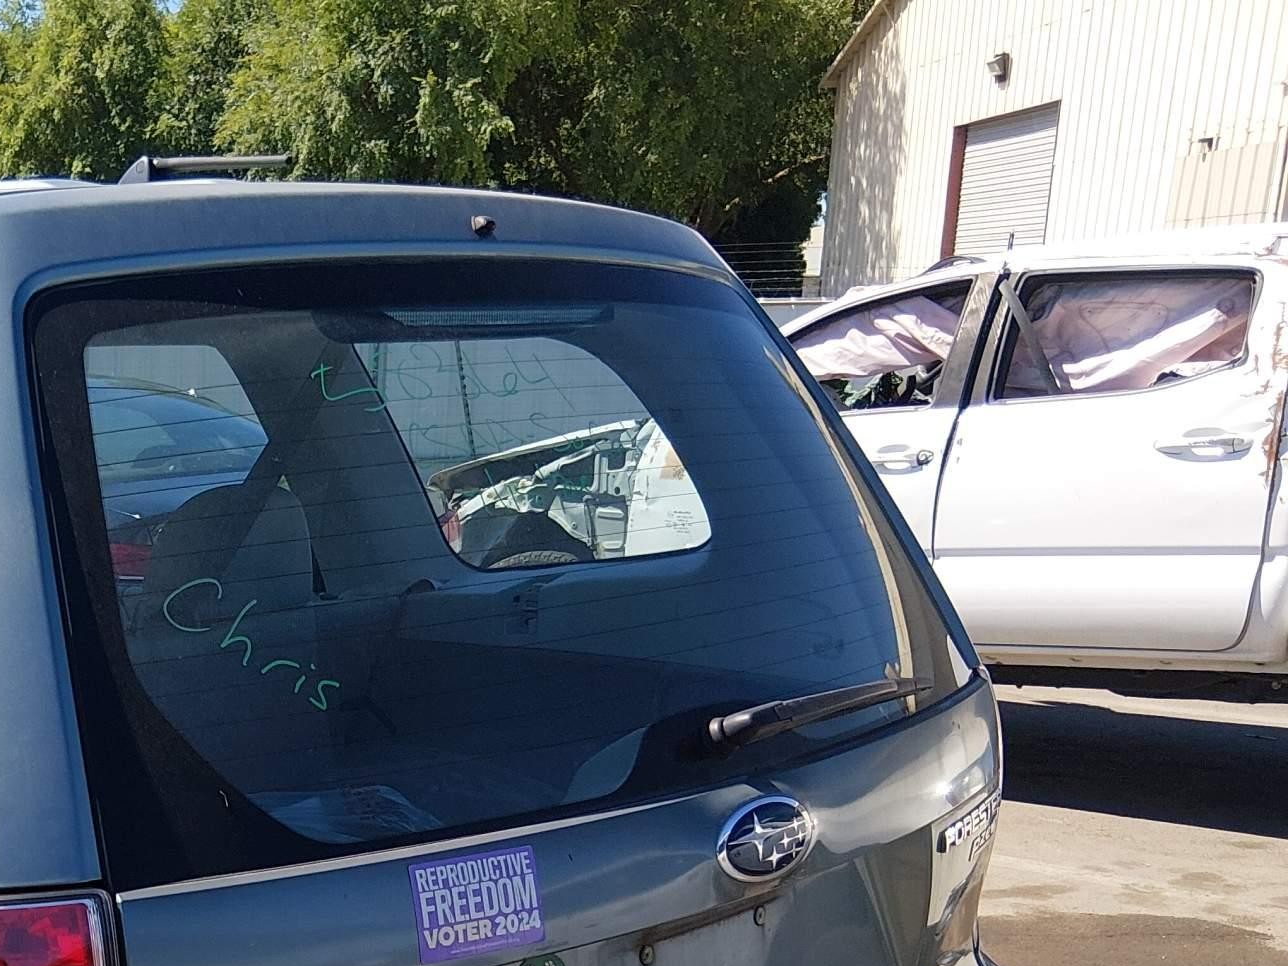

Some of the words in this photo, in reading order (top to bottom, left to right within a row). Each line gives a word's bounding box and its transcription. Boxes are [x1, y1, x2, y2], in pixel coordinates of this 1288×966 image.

[163, 577, 340, 711] Chris
[415, 852, 532, 893] REPRODUCTIVE
[419, 873, 538, 929] FREEDOM
[423, 919, 492, 949] VOTER
[495, 909, 541, 936] 2024
